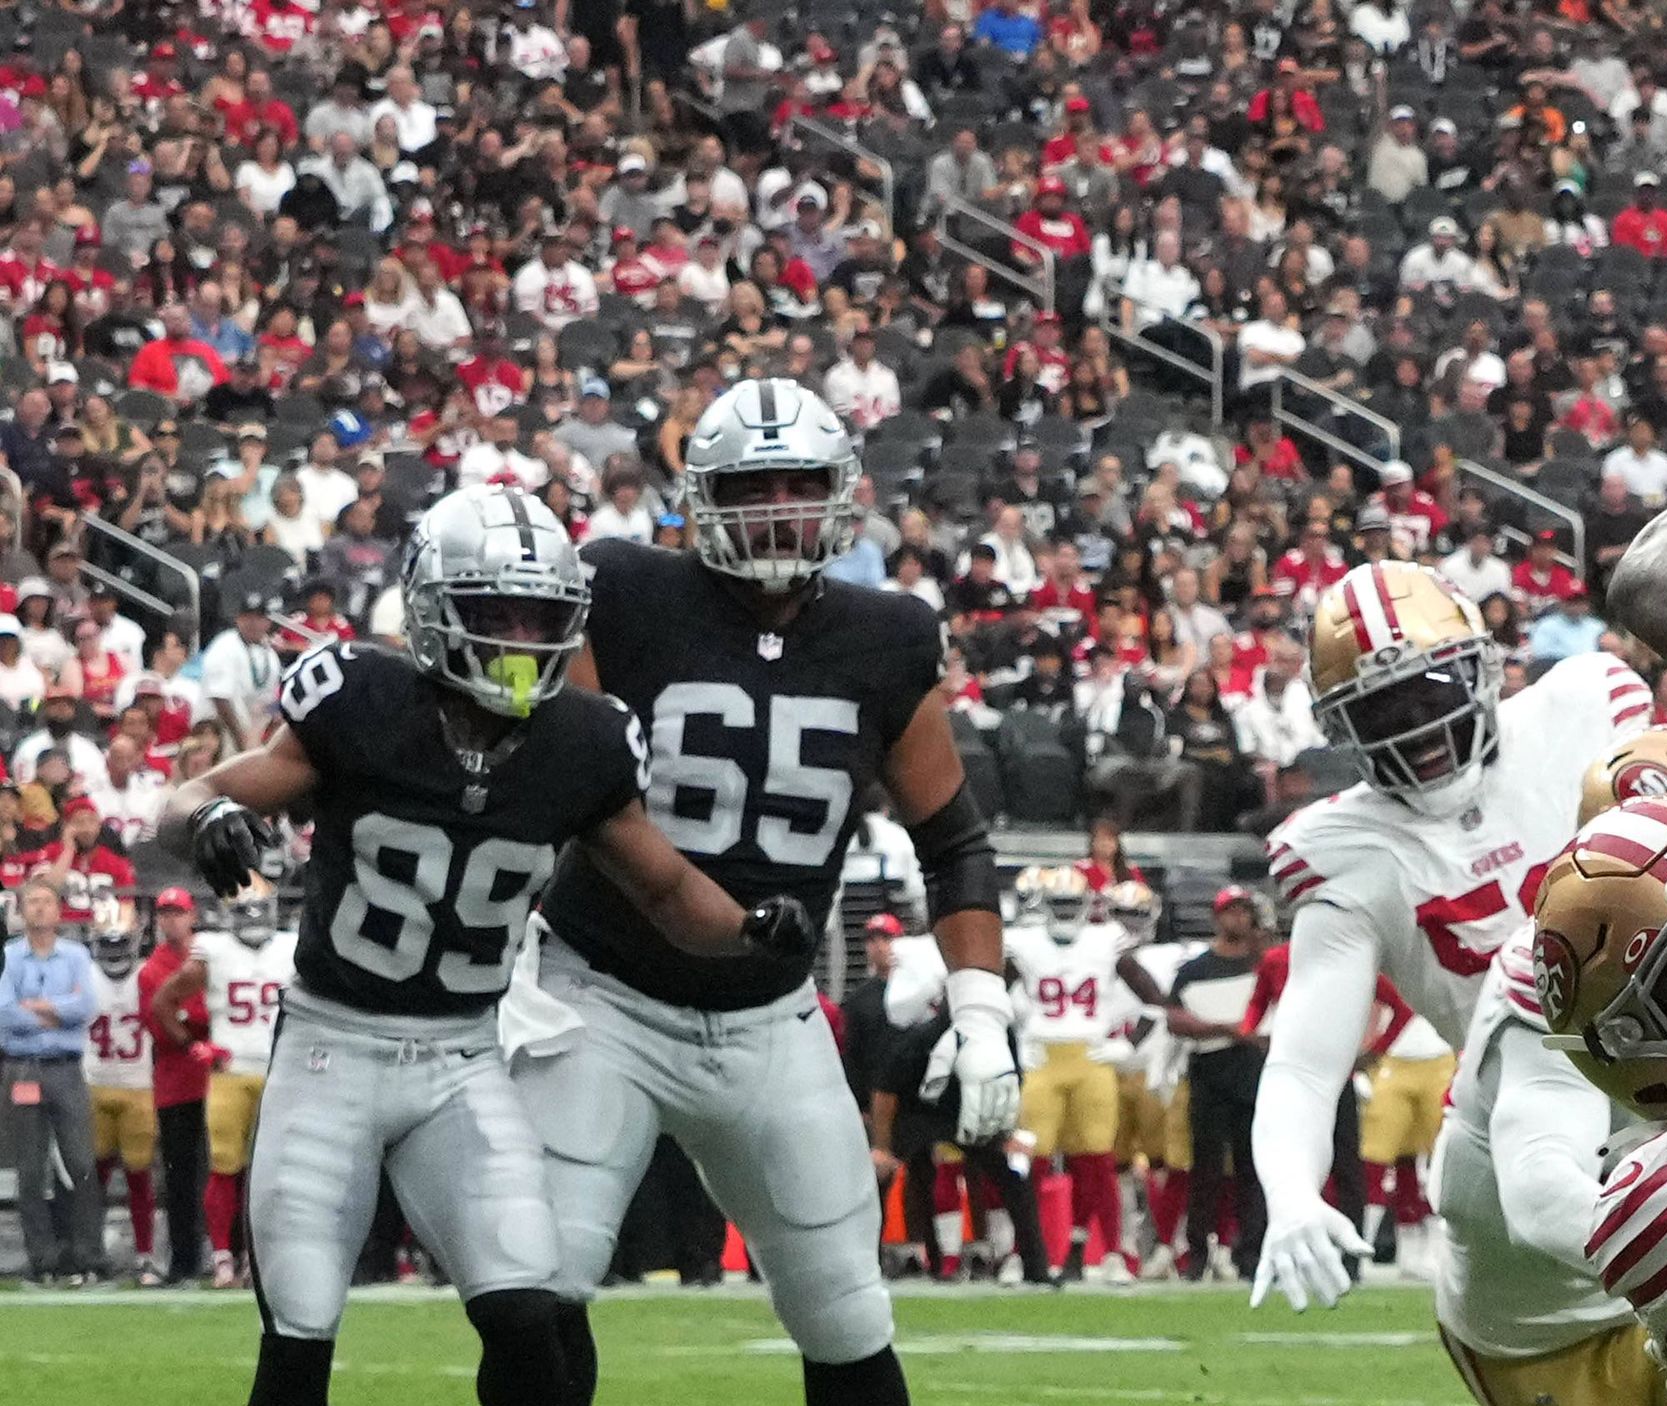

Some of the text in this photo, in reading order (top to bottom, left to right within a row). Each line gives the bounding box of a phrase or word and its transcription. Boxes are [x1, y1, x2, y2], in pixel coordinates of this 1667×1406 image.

[648, 682, 860, 867] 65
[330, 811, 556, 994] 89
[89, 1013, 143, 1060] 43
[1037, 977, 1098, 1018] 94
